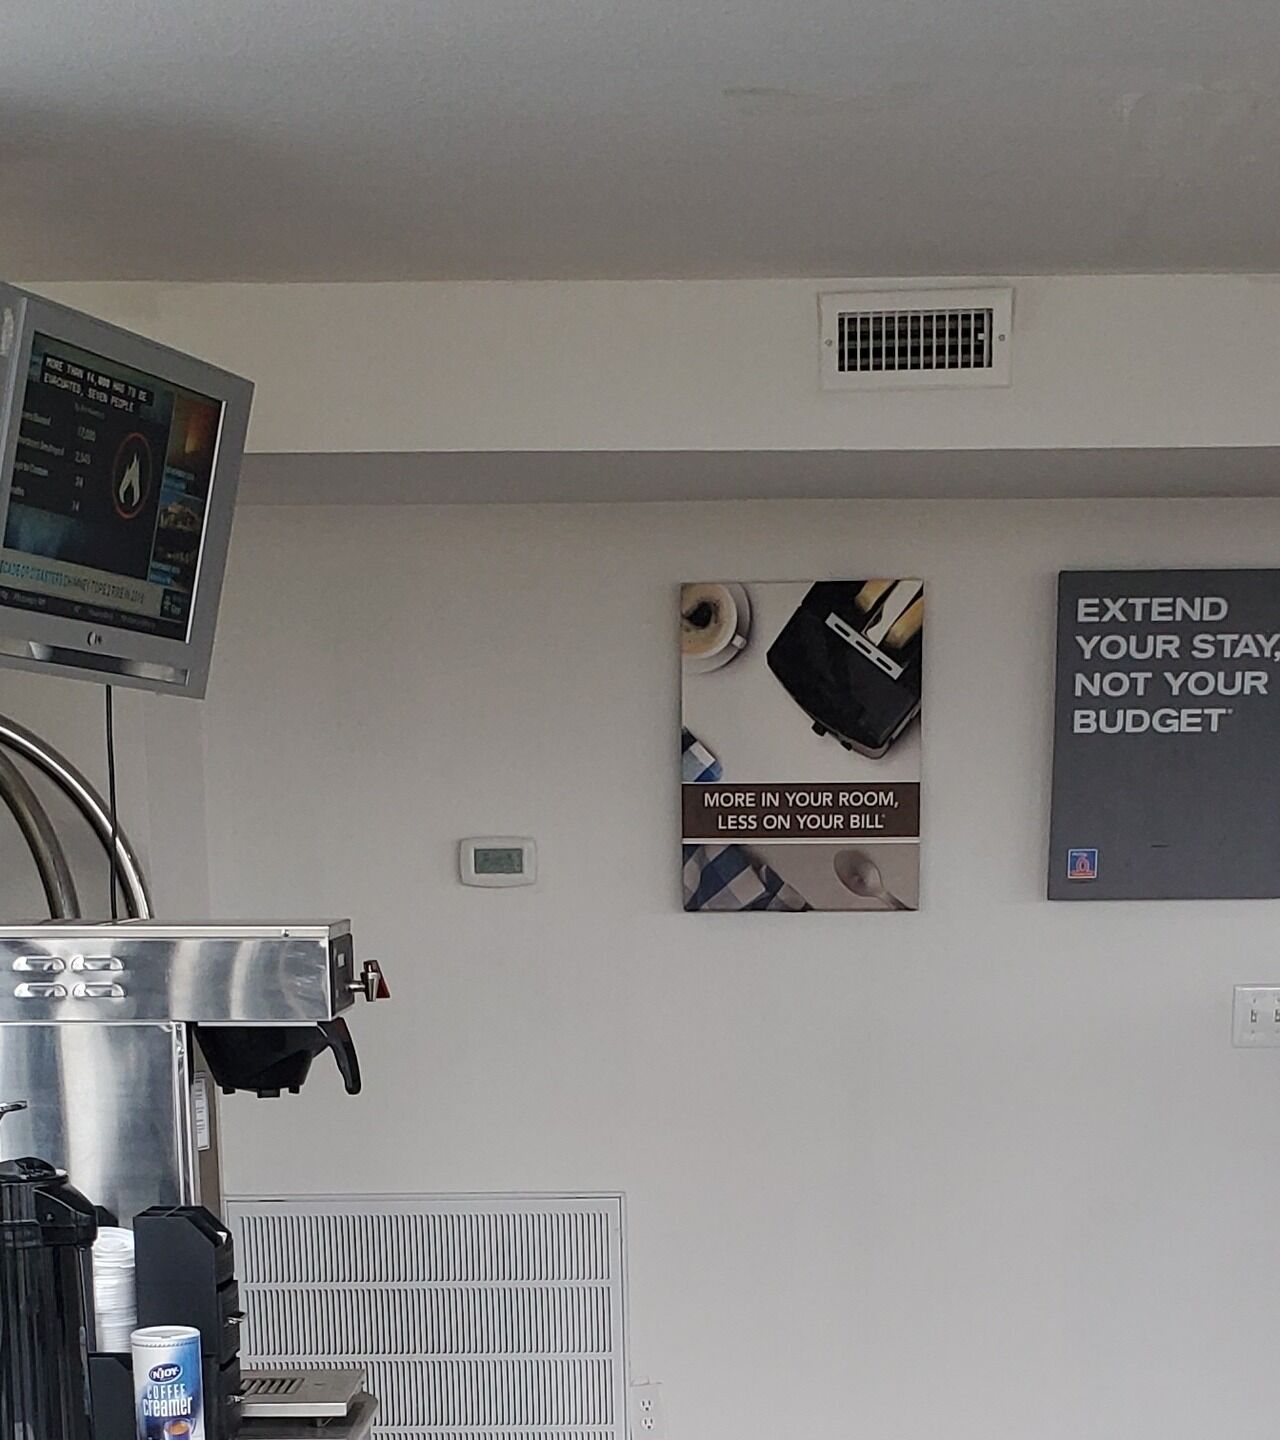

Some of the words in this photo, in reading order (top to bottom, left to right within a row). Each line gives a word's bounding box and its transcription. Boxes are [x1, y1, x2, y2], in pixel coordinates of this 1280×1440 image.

[45, 357, 63, 372] MORE
[67, 363, 84, 379] THAN
[128, 386, 136, 398] TO
[138, 390, 147, 402] BE
[88, 387, 108, 403] SEVEN
[111, 395, 134, 412] PEOPLE
[1076, 597, 1228, 623] EXTEND
[1075, 634, 1181, 660] YOUR
[1074, 671, 1153, 697] NOT
[1163, 671, 1269, 696] YOUR
[1073, 708, 1228, 734] BUDGET
[704, 792, 755, 808] MORE
[761, 792, 779, 808] IN
[784, 792, 835, 807] YOUR
[839, 791, 899, 809] ROOM,
[718, 814, 757, 830] LESS
[763, 814, 791, 830] ON
[796, 814, 844, 829] YOUR
[850, 814, 884, 829] BILL
[147, 1383, 186, 1400] COFFEE
